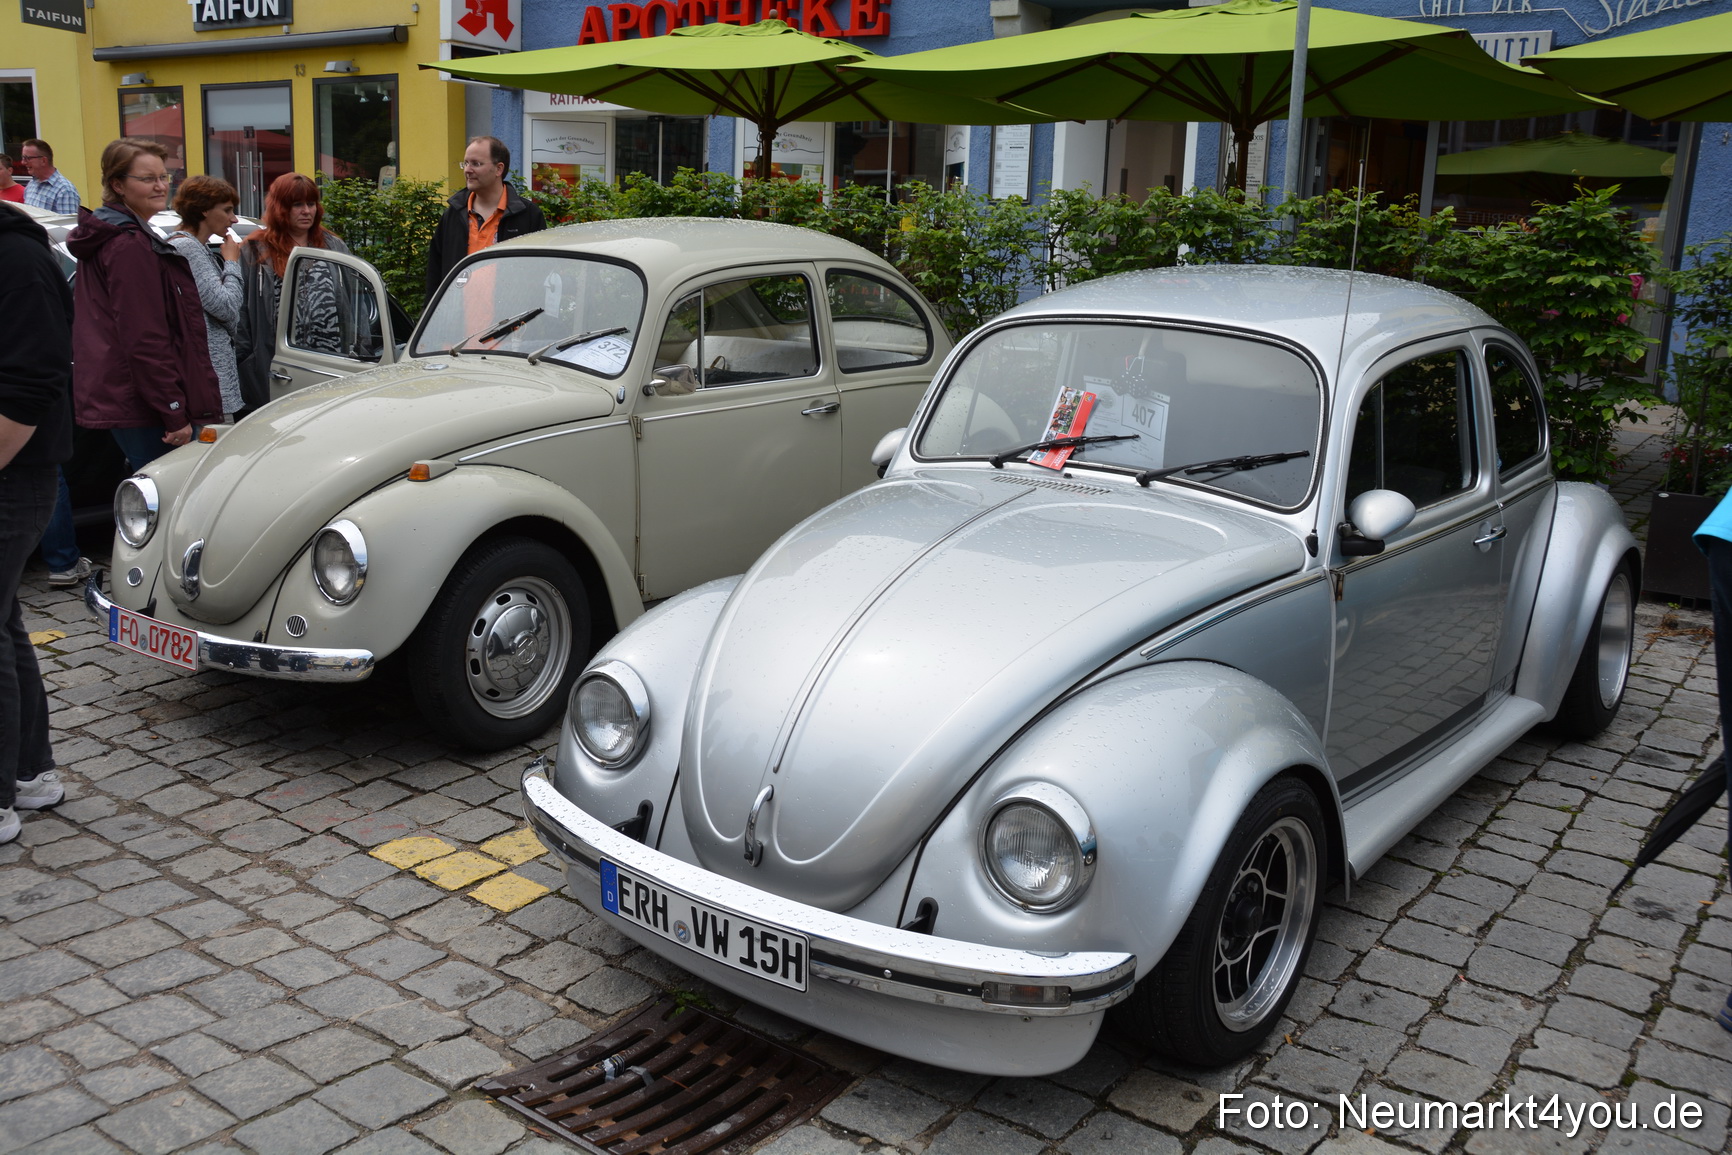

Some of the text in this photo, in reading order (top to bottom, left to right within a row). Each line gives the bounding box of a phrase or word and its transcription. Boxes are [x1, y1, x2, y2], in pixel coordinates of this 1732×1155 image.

[26, 7, 83, 27] TAIFUN
[187, 0, 280, 23] TAIFUN
[577, 0, 891, 45] APOTHEKE
[294, 63, 306, 77] 13
[597, 341, 628, 359] 372
[1131, 403, 1156, 429] 407
[120, 614, 193, 664] FO 0782
[607, 890, 614, 902] D
[618, 873, 803, 984] ERH VW 15H
